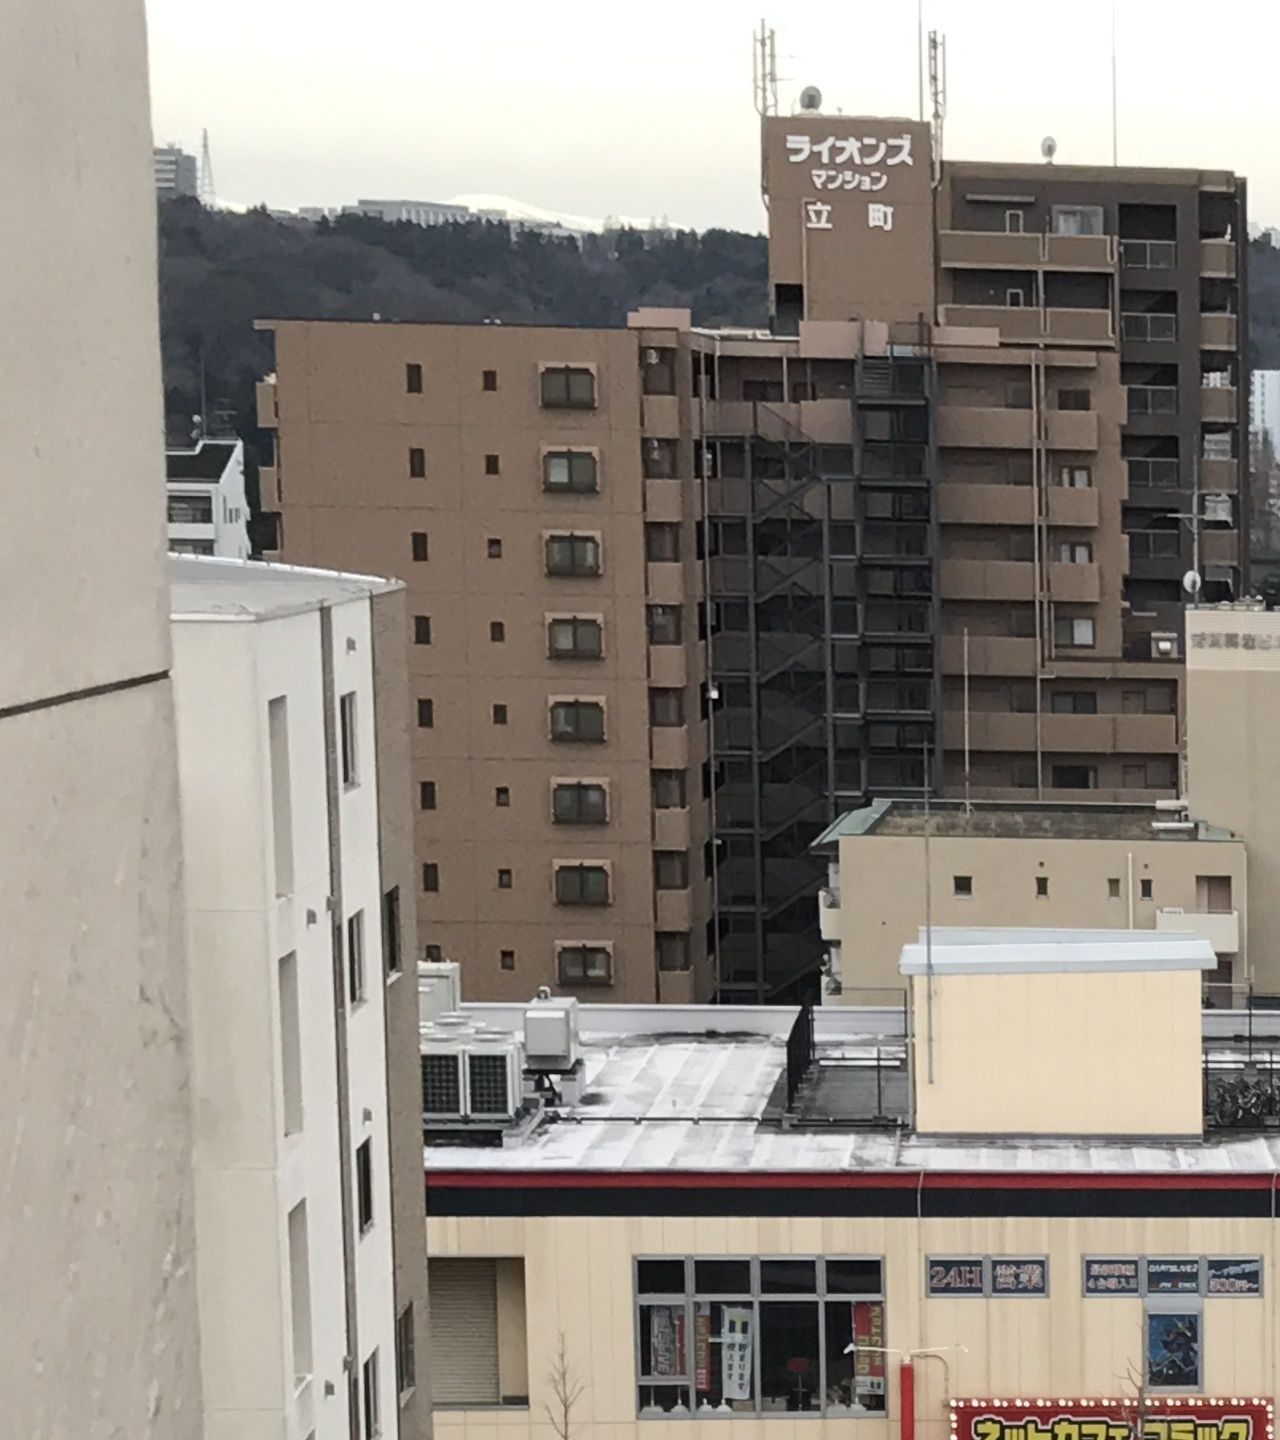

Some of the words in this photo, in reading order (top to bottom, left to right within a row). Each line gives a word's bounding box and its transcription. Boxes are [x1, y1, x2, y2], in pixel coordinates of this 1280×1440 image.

[786, 134, 913, 166] ライオンズ
[811, 169, 888, 190] マンション
[929, 1264, 983, 1289] 24H
[993, 1263, 1045, 1290] 営業
